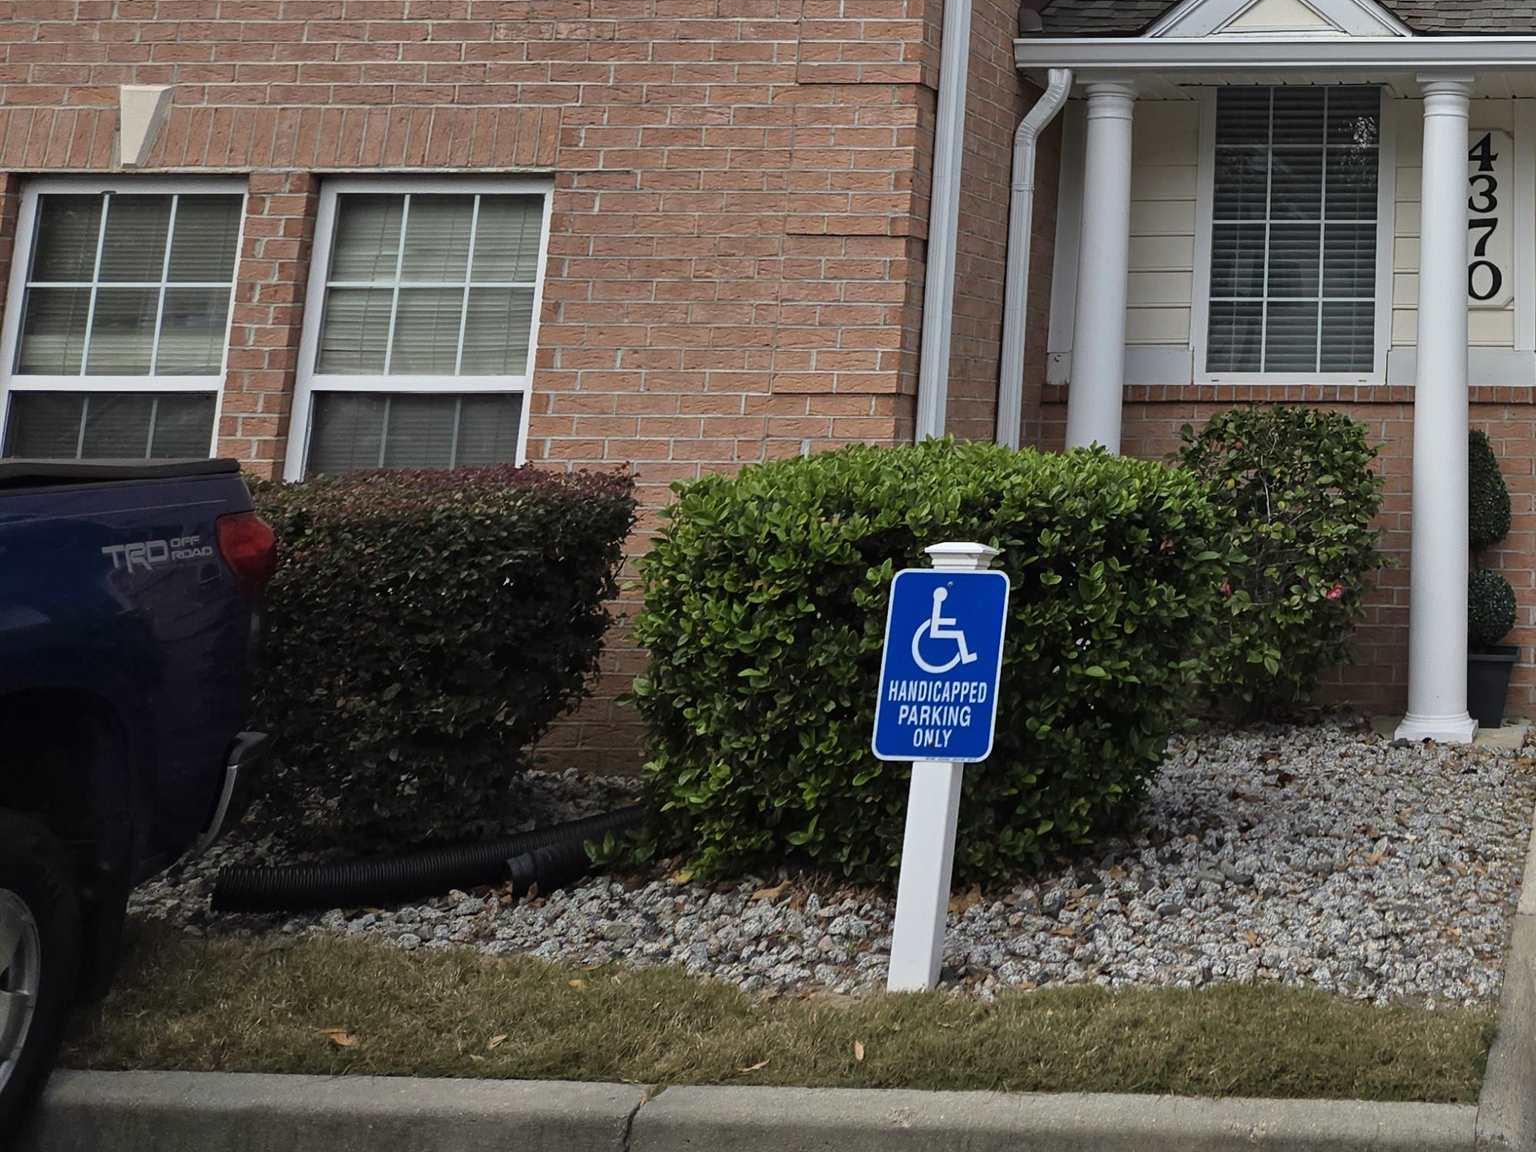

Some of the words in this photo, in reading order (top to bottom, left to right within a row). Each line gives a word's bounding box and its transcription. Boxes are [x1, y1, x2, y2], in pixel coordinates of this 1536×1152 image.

[1468, 132, 1503, 300] 4370
[170, 535, 200, 548] OFF
[102, 539, 169, 573] TRD
[171, 546, 213, 561] ROAD
[888, 680, 987, 704] HANDICAPPED
[898, 705, 972, 727] PARKING
[913, 728, 953, 748] ONLY
